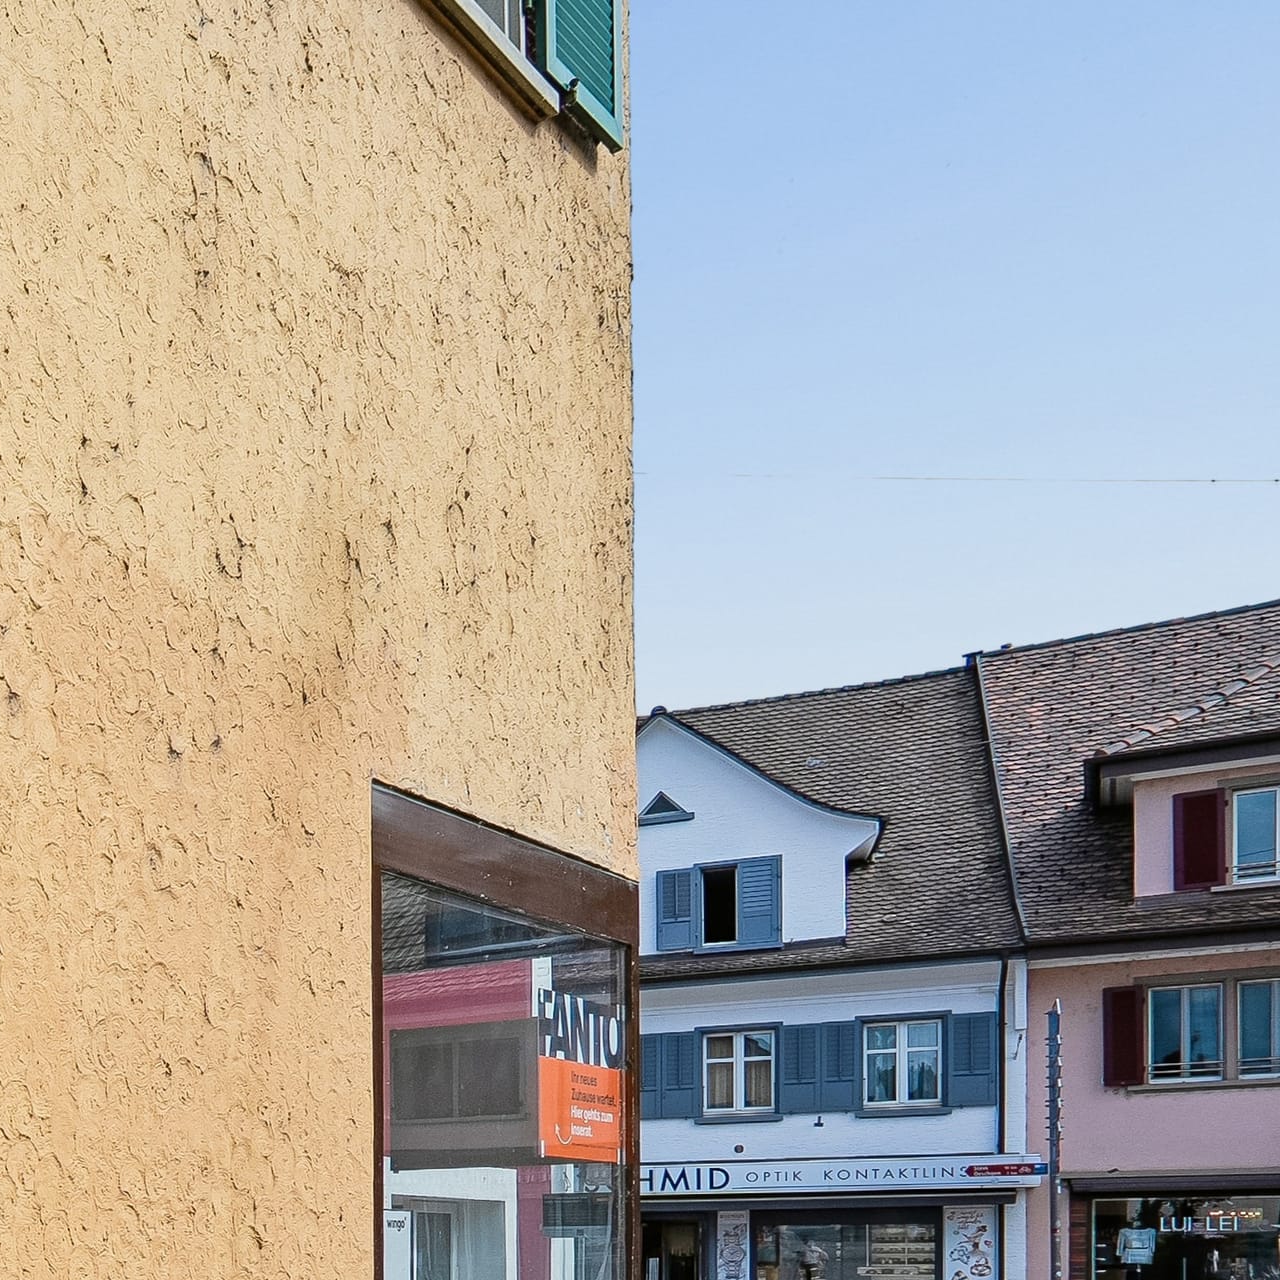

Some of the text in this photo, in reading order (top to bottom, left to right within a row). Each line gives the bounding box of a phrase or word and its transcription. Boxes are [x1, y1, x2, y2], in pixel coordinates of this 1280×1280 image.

[580, 1074, 598, 1087] neues
[571, 1087, 596, 1104] Zuhause
[570, 1104, 583, 1119] Hier
[600, 1112, 614, 1123] zum
[745, 1170, 803, 1183] OPTIK
[1206, 1216, 1238, 1232] LEI
